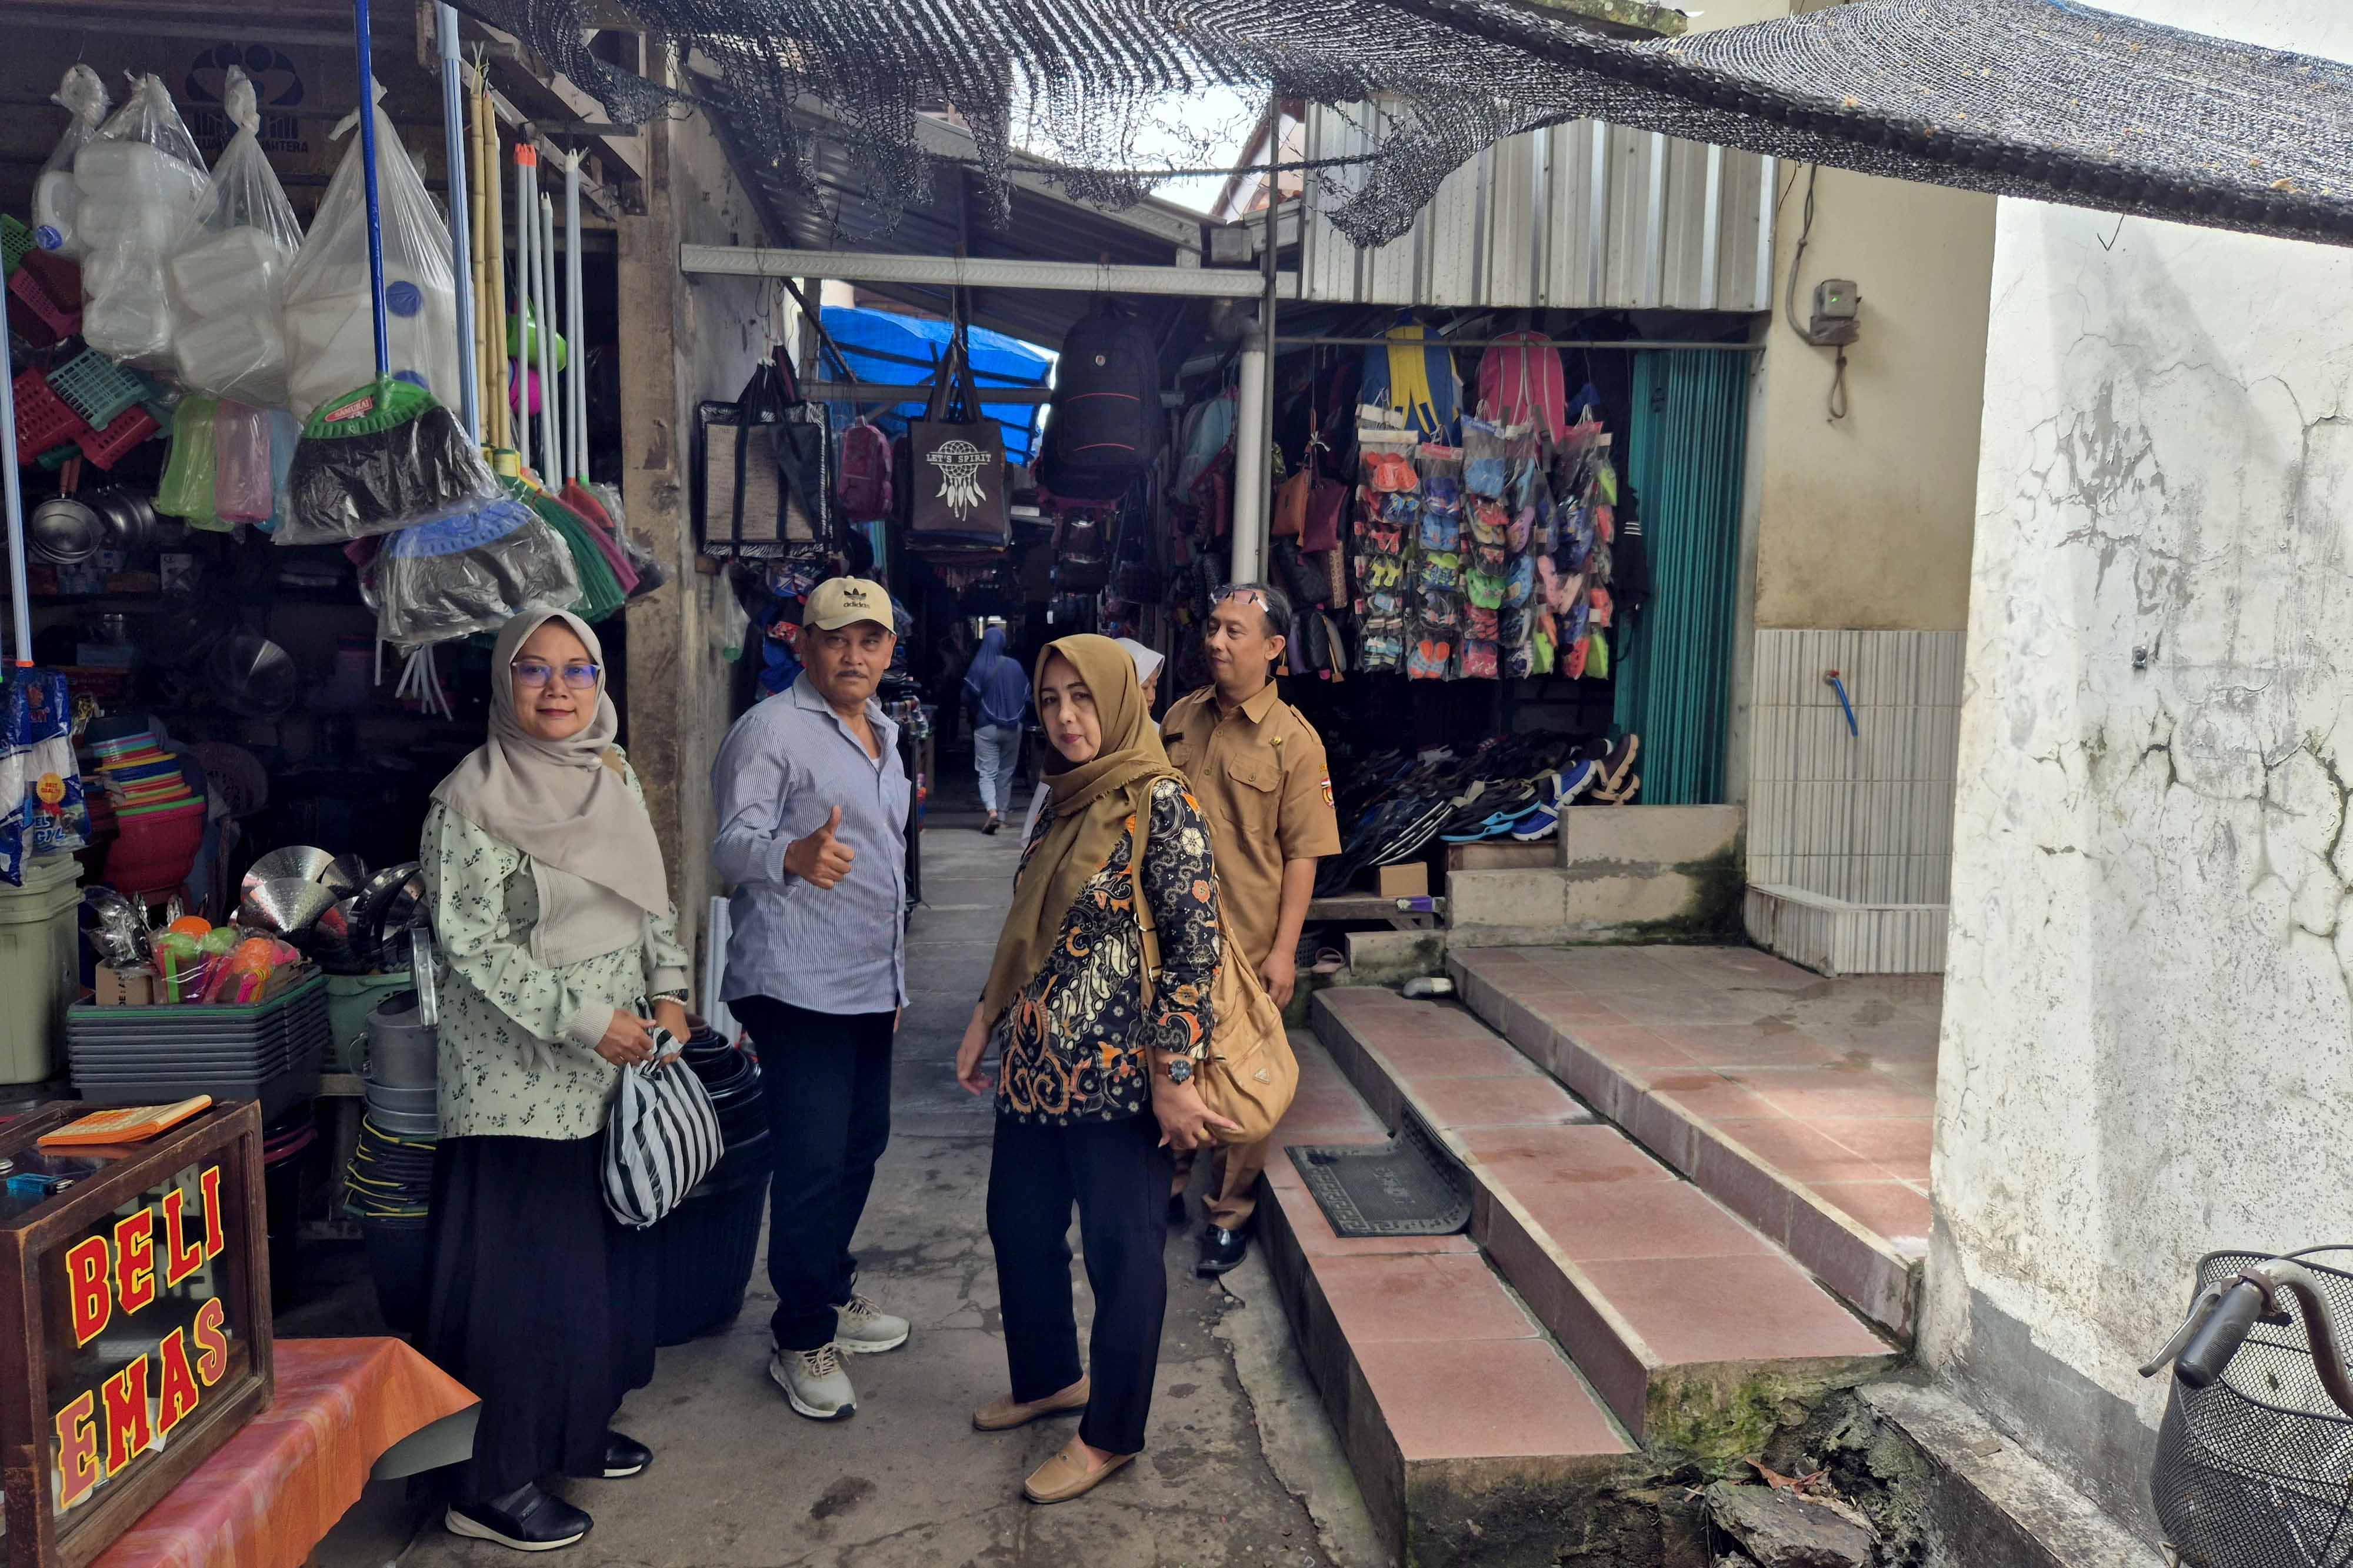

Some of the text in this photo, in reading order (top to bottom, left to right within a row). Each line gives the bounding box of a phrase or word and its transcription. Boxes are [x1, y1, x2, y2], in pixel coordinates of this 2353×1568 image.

[335, 397, 372, 417] SAMURAI
[926, 453, 991, 463] LET'S SPIRIT
[843, 601, 871, 609] adidas
[66, 1165, 224, 1349] BELI
[55, 1297, 228, 1510] EMAS
